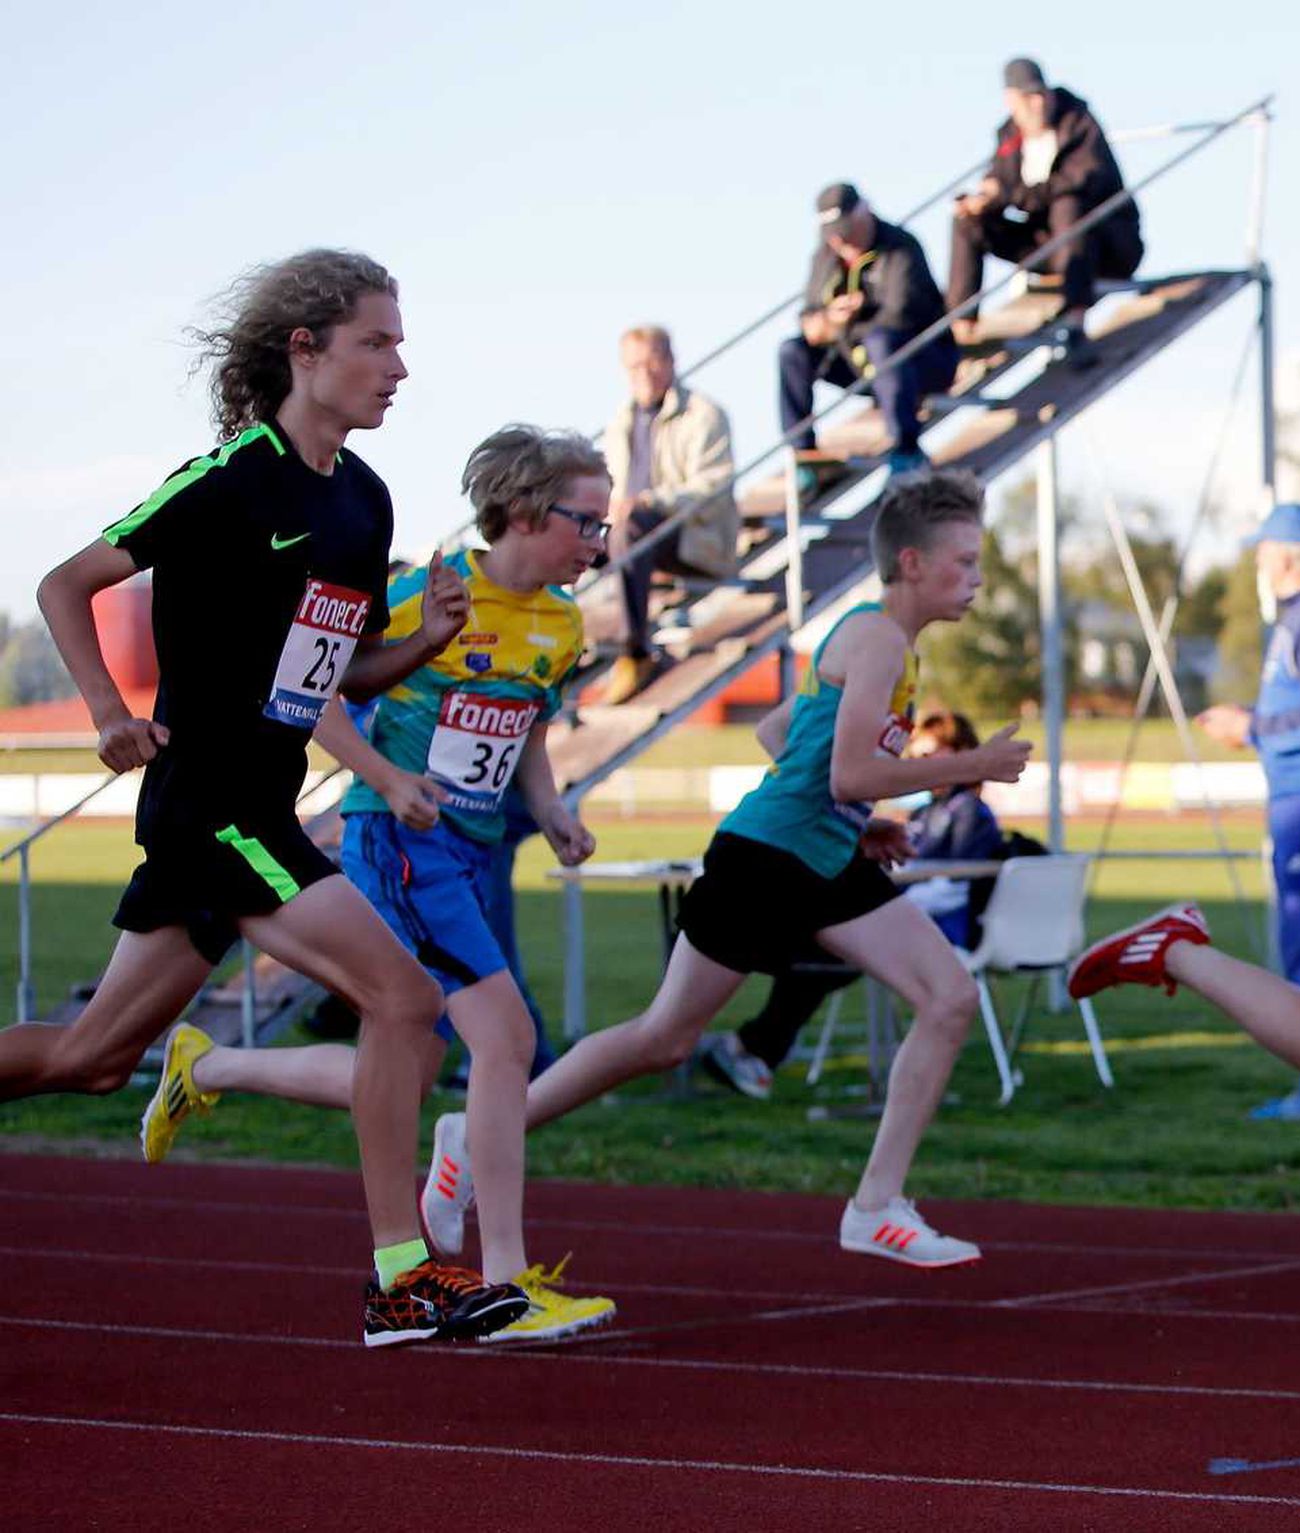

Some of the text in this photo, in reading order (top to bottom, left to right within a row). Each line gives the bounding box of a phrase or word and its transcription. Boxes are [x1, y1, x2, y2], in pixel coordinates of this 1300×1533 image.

[300, 580, 368, 635] Fonect
[301, 637, 340, 692] 25
[463, 742, 516, 788] 36
